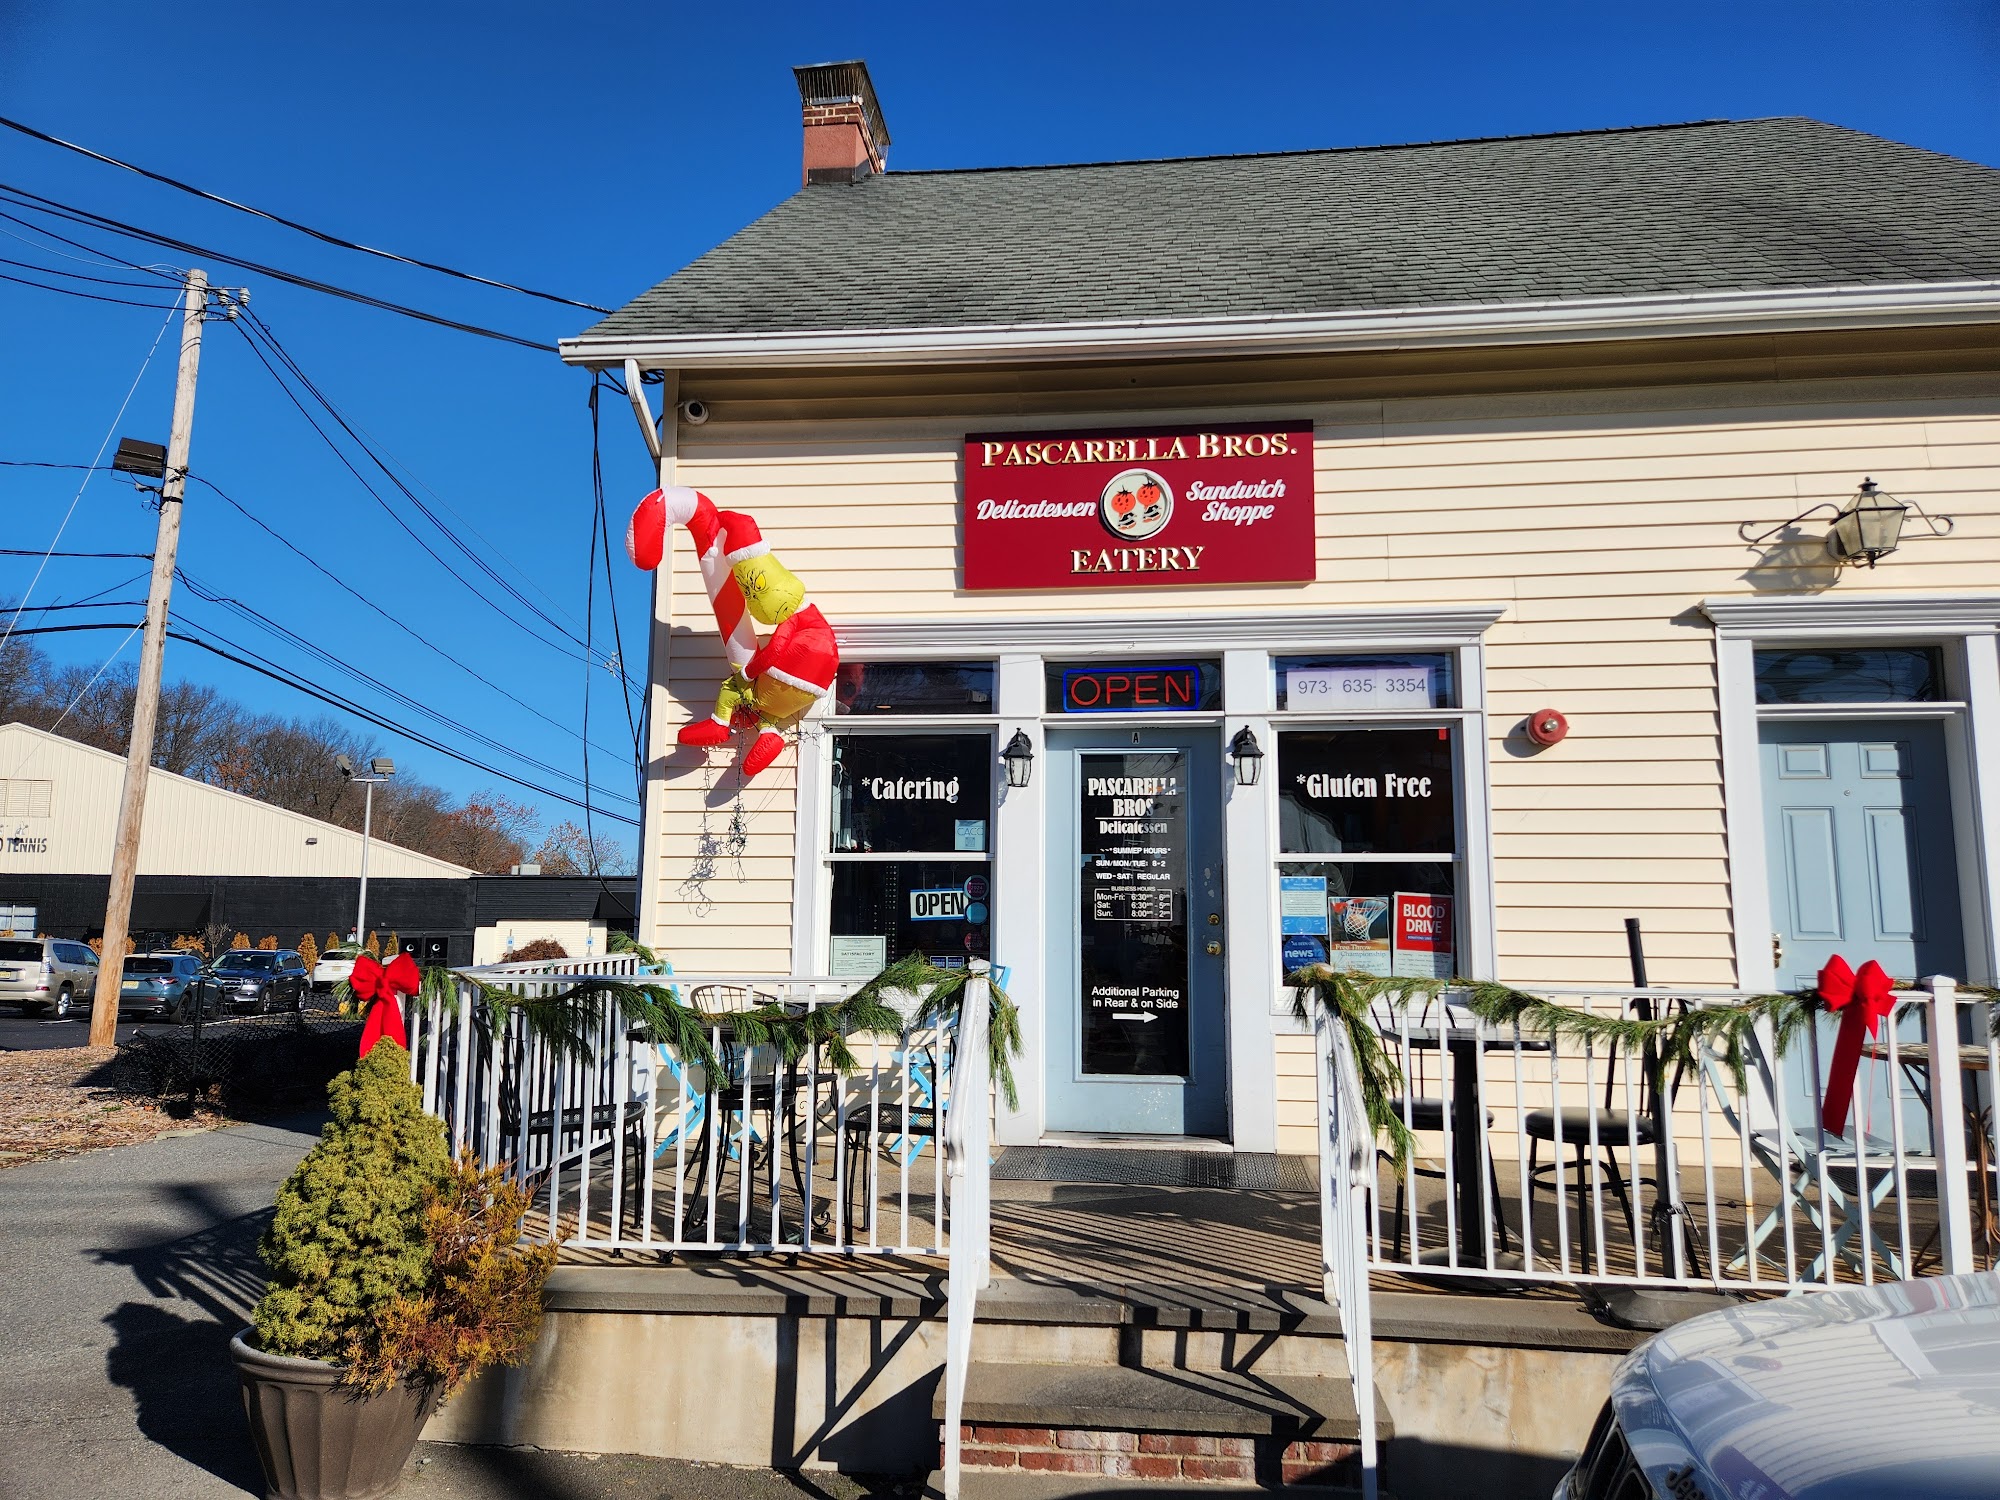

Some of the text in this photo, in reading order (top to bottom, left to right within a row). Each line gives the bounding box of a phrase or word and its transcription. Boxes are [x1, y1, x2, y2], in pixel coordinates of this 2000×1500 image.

[981, 432, 1298, 467] PASCARELLA BROS.
[1186, 478, 1286, 502] Sandwich
[976, 499, 1096, 520] Delicatessen
[1202, 501, 1275, 527] Shoppe
[1070, 546, 1205, 574] EATERY
[1070, 674, 1190, 706] OPEN
[1298, 678, 1426, 694] 973- 635- 3354
[1133, 732, 1139, 743] A
[1385, 773, 1431, 798] Free
[1112, 798, 1154, 816] BROS
[1100, 820, 1168, 834] Delicatessen
[7, 837, 47, 853] TENNIS
[915, 892, 964, 916] OPEN
[1097, 901, 1111, 909] Sat:
[1403, 903, 1446, 918] BLOOD
[1097, 909, 1113, 917] Sun:
[1406, 919, 1442, 933] DRIVE
[1091, 986, 1180, 999] Additional Parking
[1092, 998, 1178, 1008] in Rear & on Side
[1665, 1464, 1709, 1500] Jee
